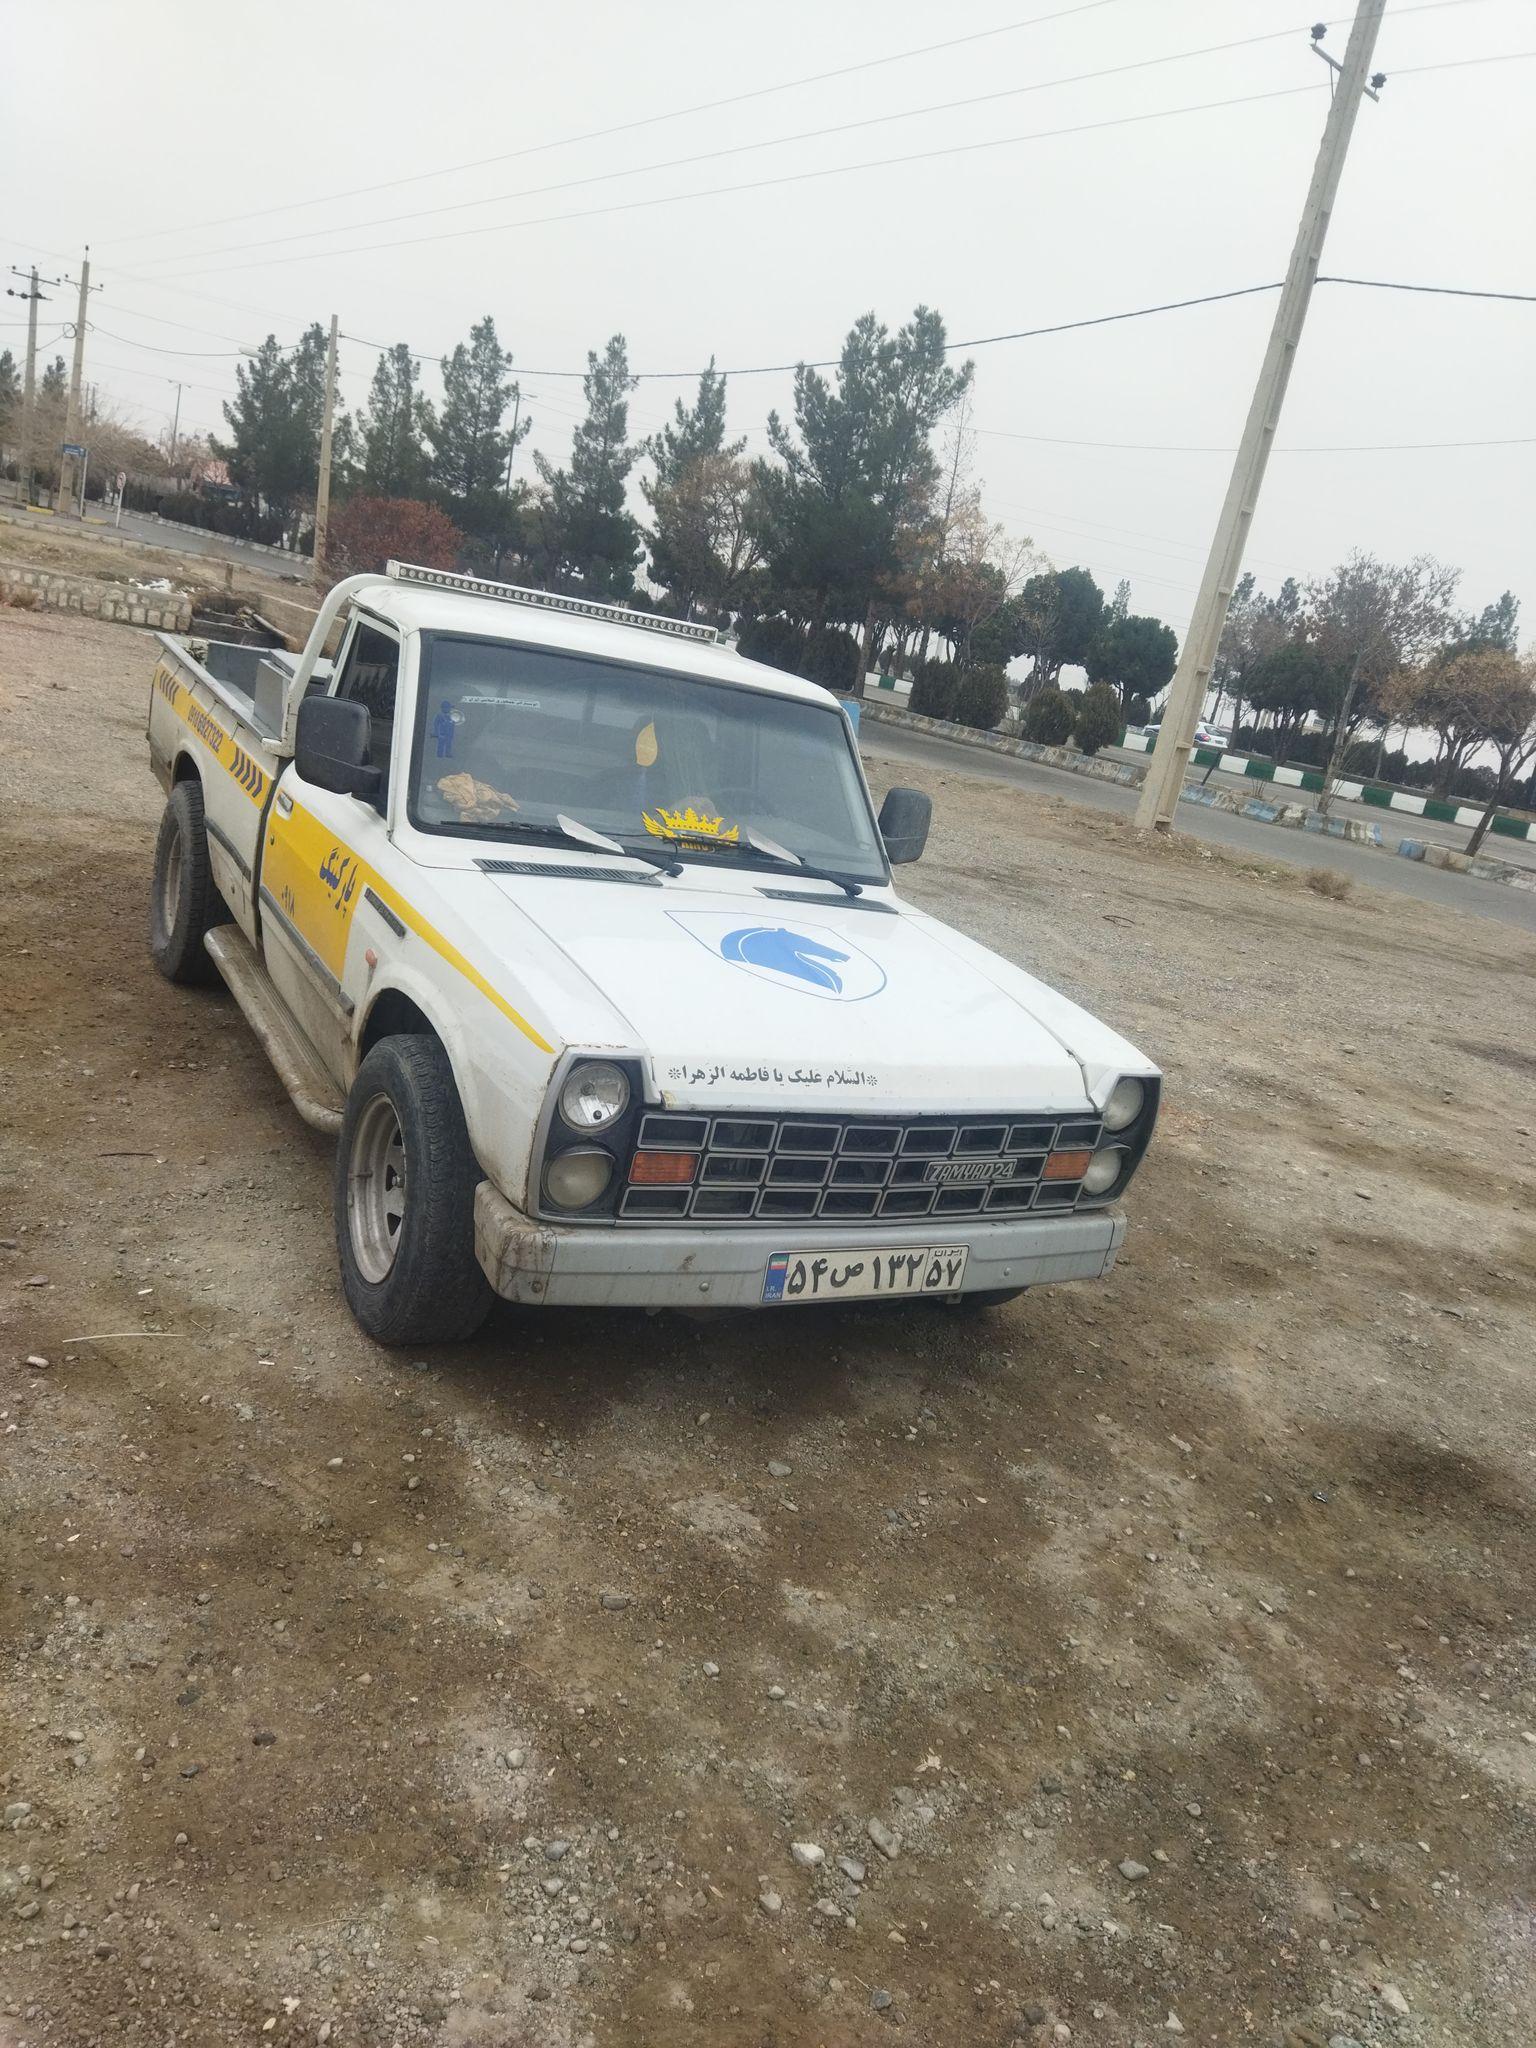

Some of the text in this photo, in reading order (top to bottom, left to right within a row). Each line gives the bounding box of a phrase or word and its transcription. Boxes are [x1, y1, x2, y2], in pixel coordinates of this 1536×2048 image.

[683, 1064, 725, 1085] الزهرا
[730, 1066, 769, 1082] فاطمه
[773, 1067, 785, 1086] یا
[765, 1291, 782, 1299] IRAN
